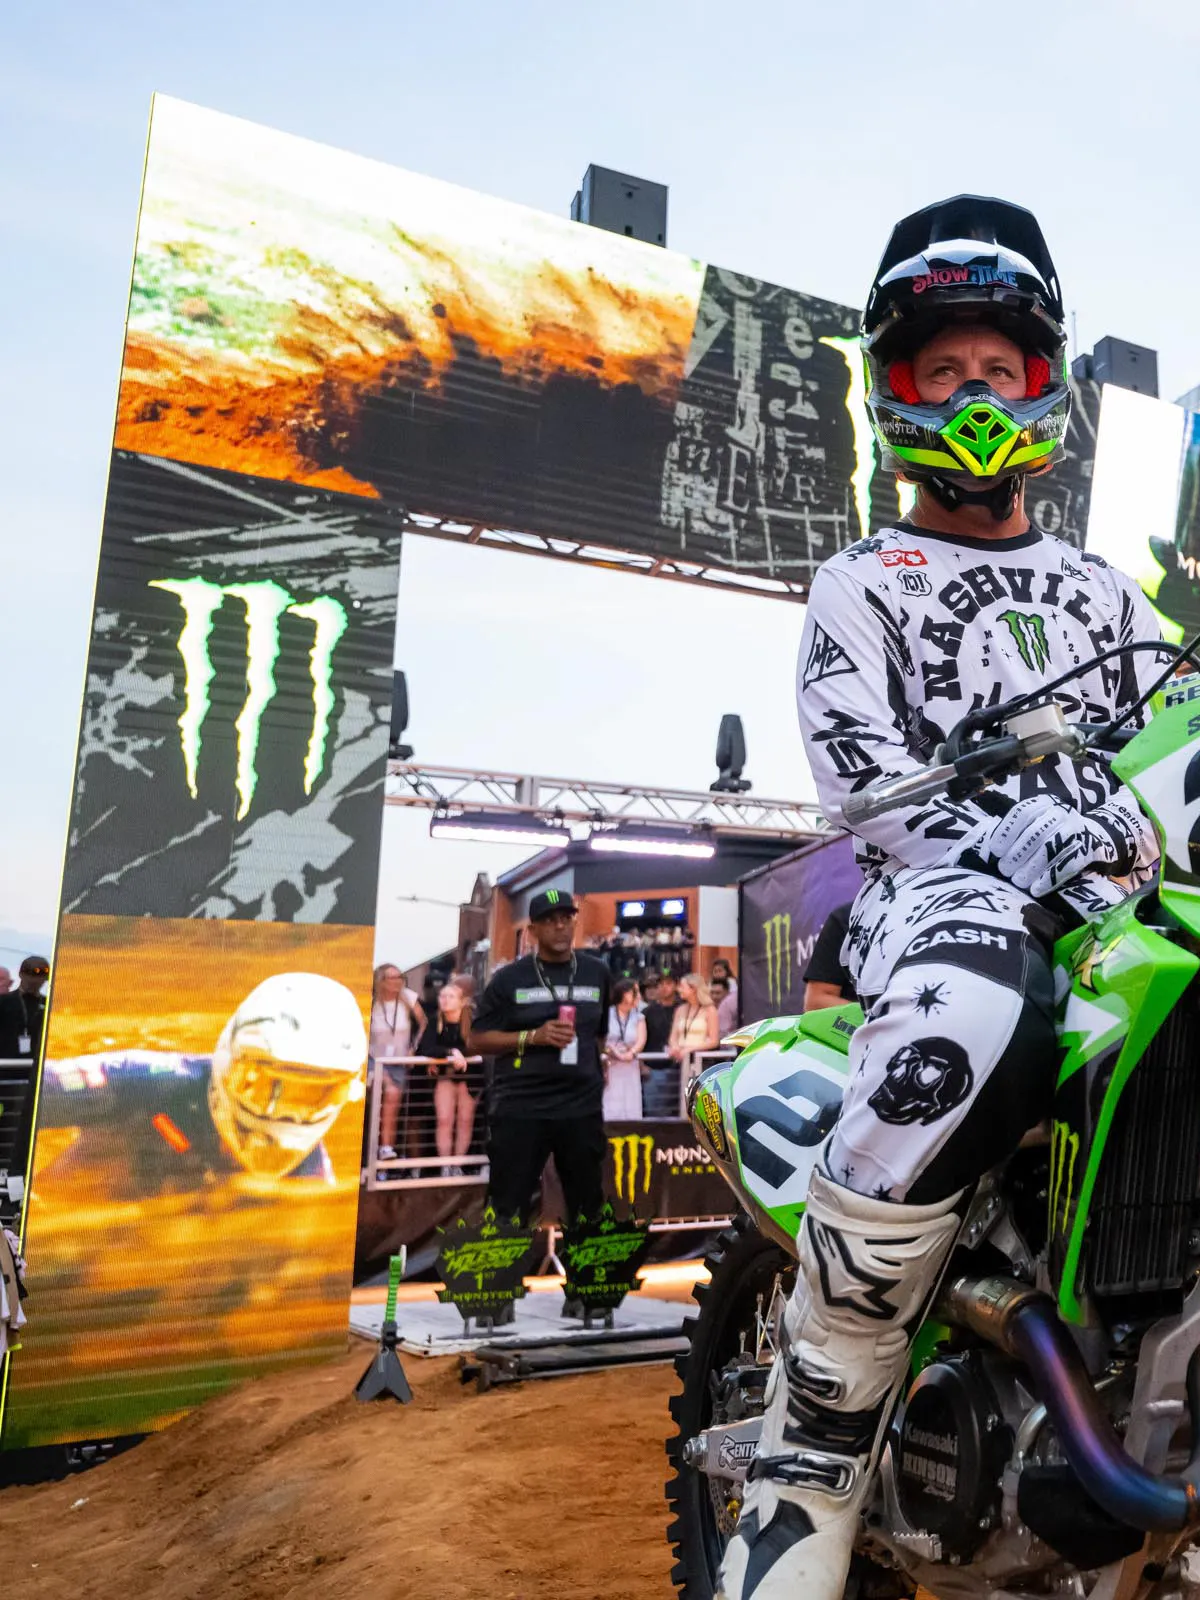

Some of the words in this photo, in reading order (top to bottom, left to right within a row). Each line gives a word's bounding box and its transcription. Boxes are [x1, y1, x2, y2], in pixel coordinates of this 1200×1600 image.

[905, 928, 1008, 957] CASH
[656, 1145, 712, 1165] MONS
[671, 1165, 716, 1175] ENER
